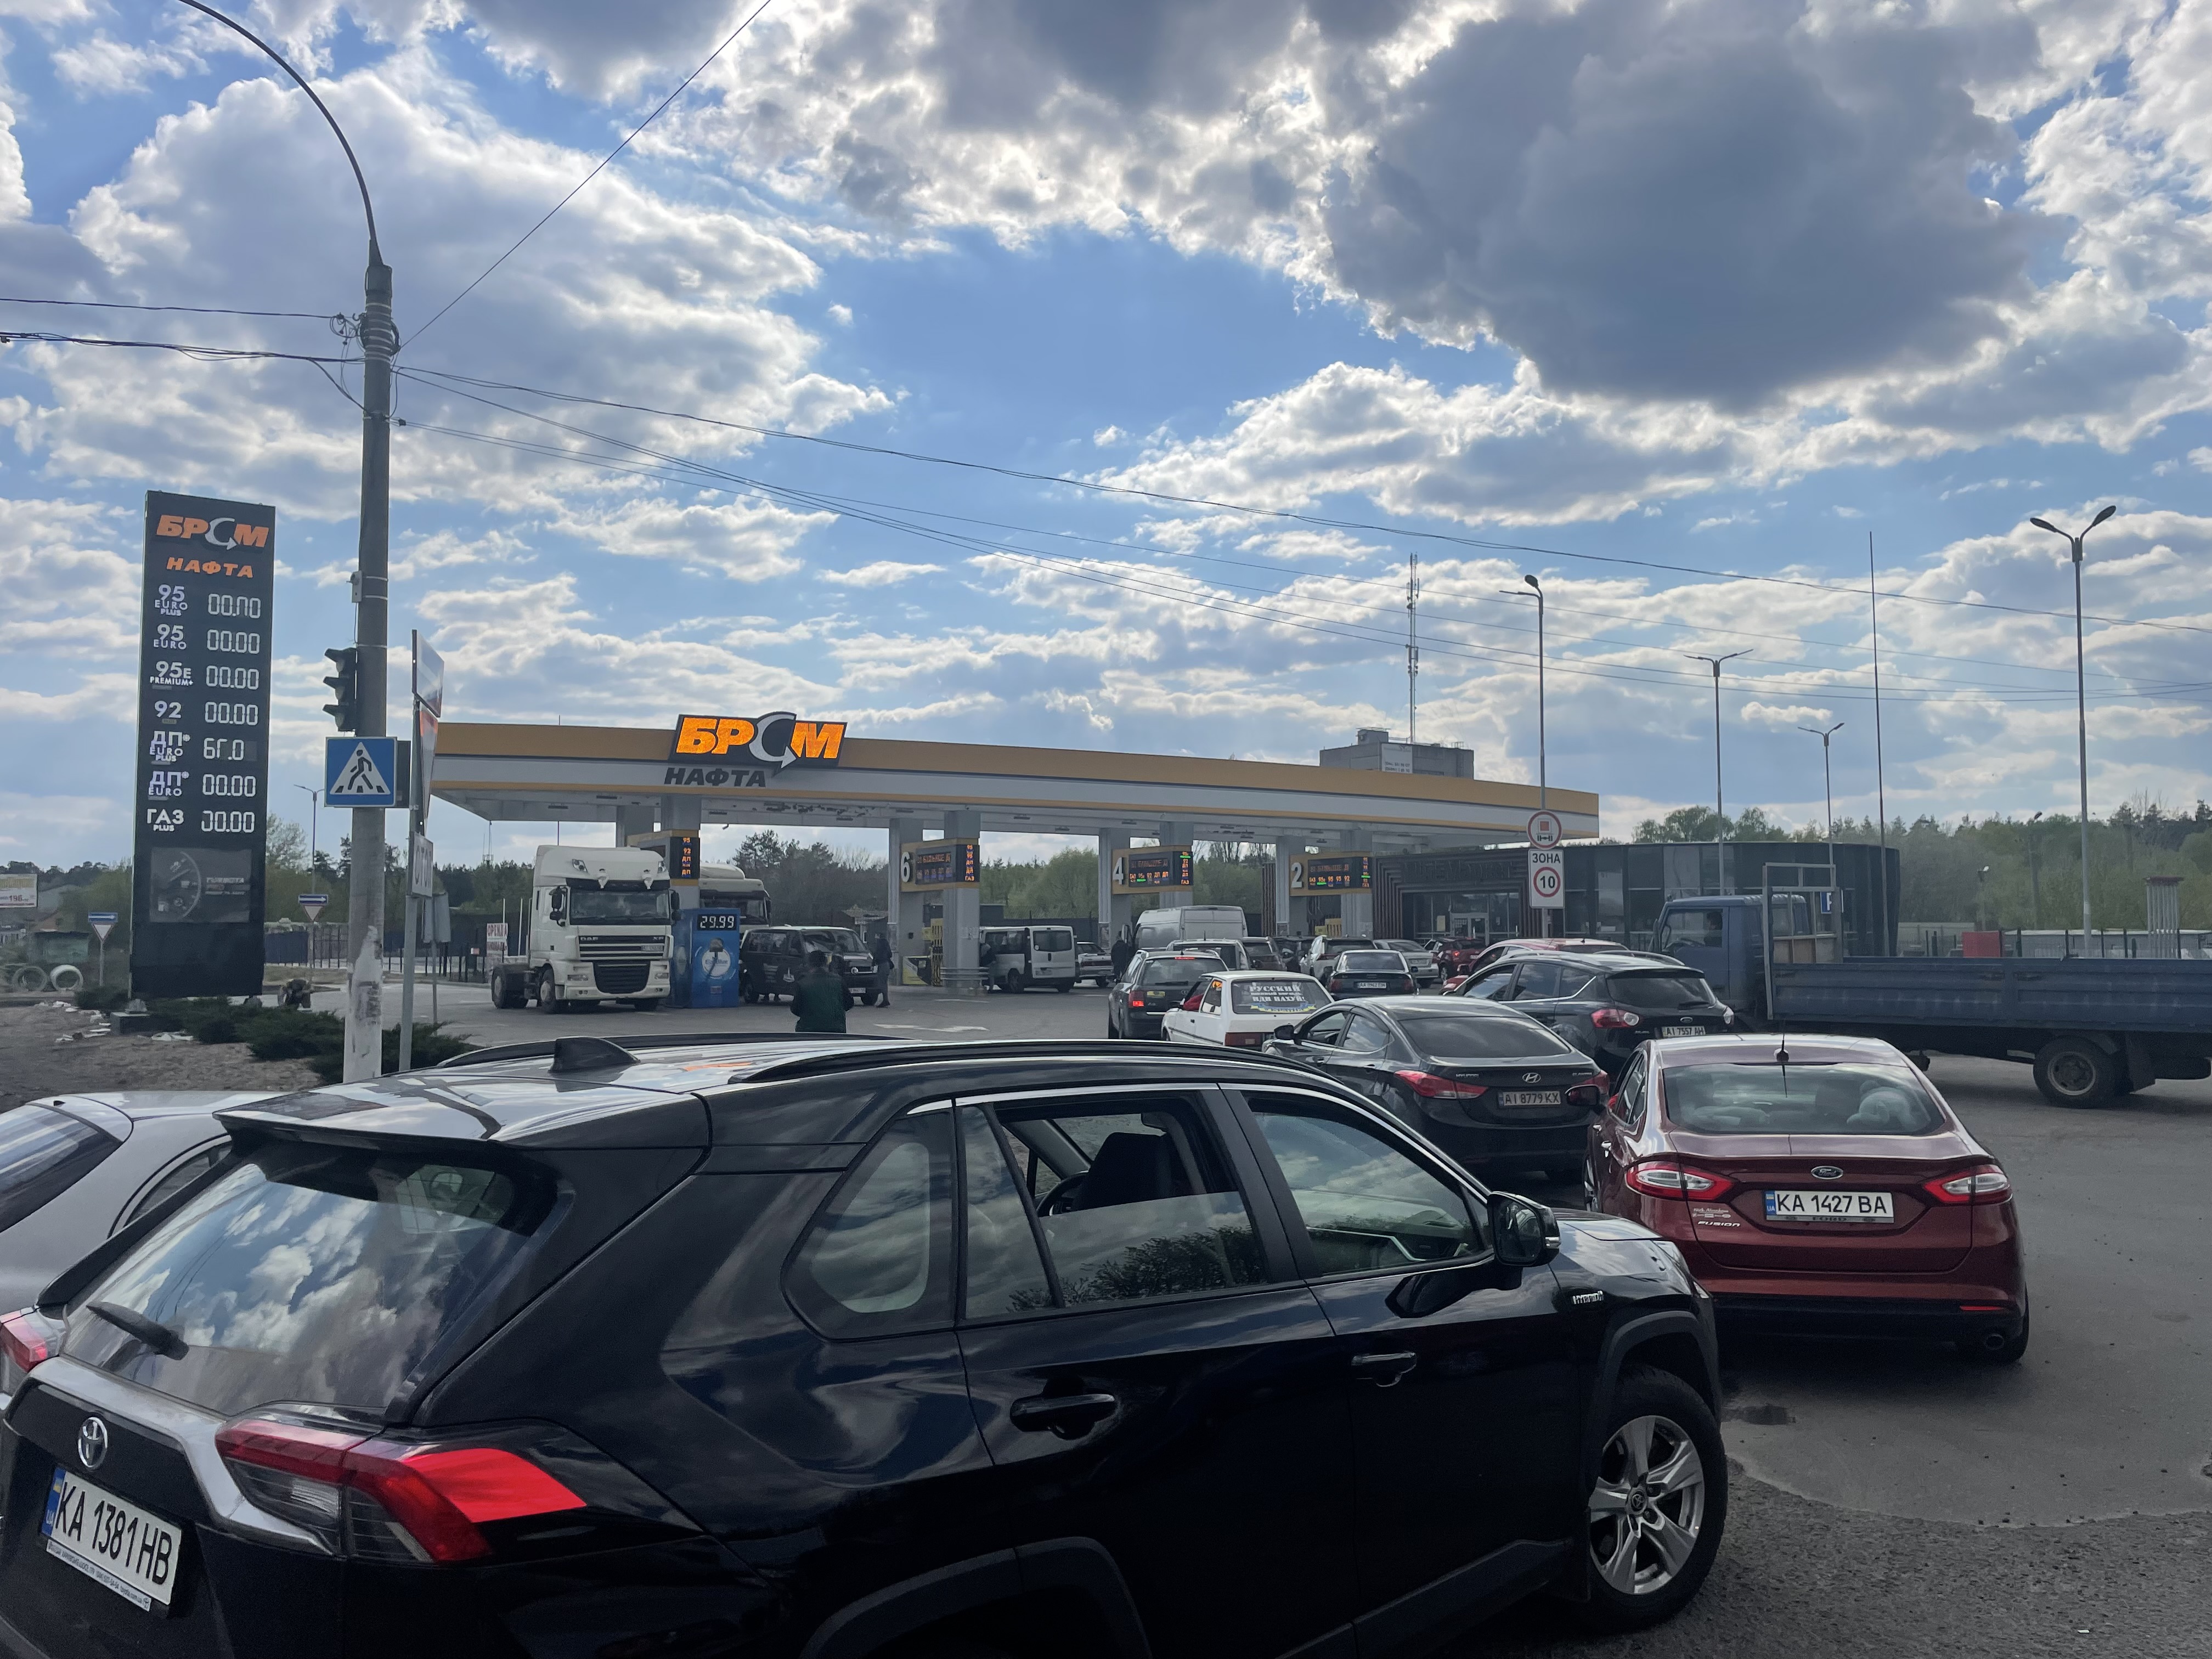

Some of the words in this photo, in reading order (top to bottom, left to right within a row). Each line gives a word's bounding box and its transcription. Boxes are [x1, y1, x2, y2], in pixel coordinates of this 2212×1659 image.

[166, 557, 253, 578] НАФТА
[159, 584, 185, 601] 95
[155, 599, 188, 610] EURO
[157, 624, 184, 641] 95
[207, 629, 260, 653] 00.00
[154, 639, 187, 650] EURO
[150, 676, 193, 686] PREMIUM+
[206, 665, 259, 690] 00.00
[154, 701, 182, 718] 92
[205, 702, 258, 725] 00.00
[150, 747, 183, 757] EURO
[202, 774, 256, 797] 00.00
[664, 768, 766, 787] НАФТА
[148, 788, 182, 796] EURO
[146, 809, 184, 824] ГАЗ
[901, 851, 910, 882] 6
[1532, 853, 1561, 864] ЗОНА
[1113, 857, 1124, 885] 4
[1291, 862, 1302, 888] 2
[1541, 876, 1555, 888] 10
[700, 916, 735, 928] 29.99
[1667, 1028, 1675, 1036] AI
[1505, 1094, 1516, 1104] AI
[1521, 1094, 1543, 1103] 8779
[1545, 1093, 1560, 1103] KX
[1777, 1194, 1805, 1212] KA
[1812, 1195, 1852, 1212] 1427
[1858, 1196, 1887, 1214] BA
[55, 1482, 85, 1542] KA
[92, 1500, 138, 1567] 1381
[136, 1523, 172, 1585] HB
